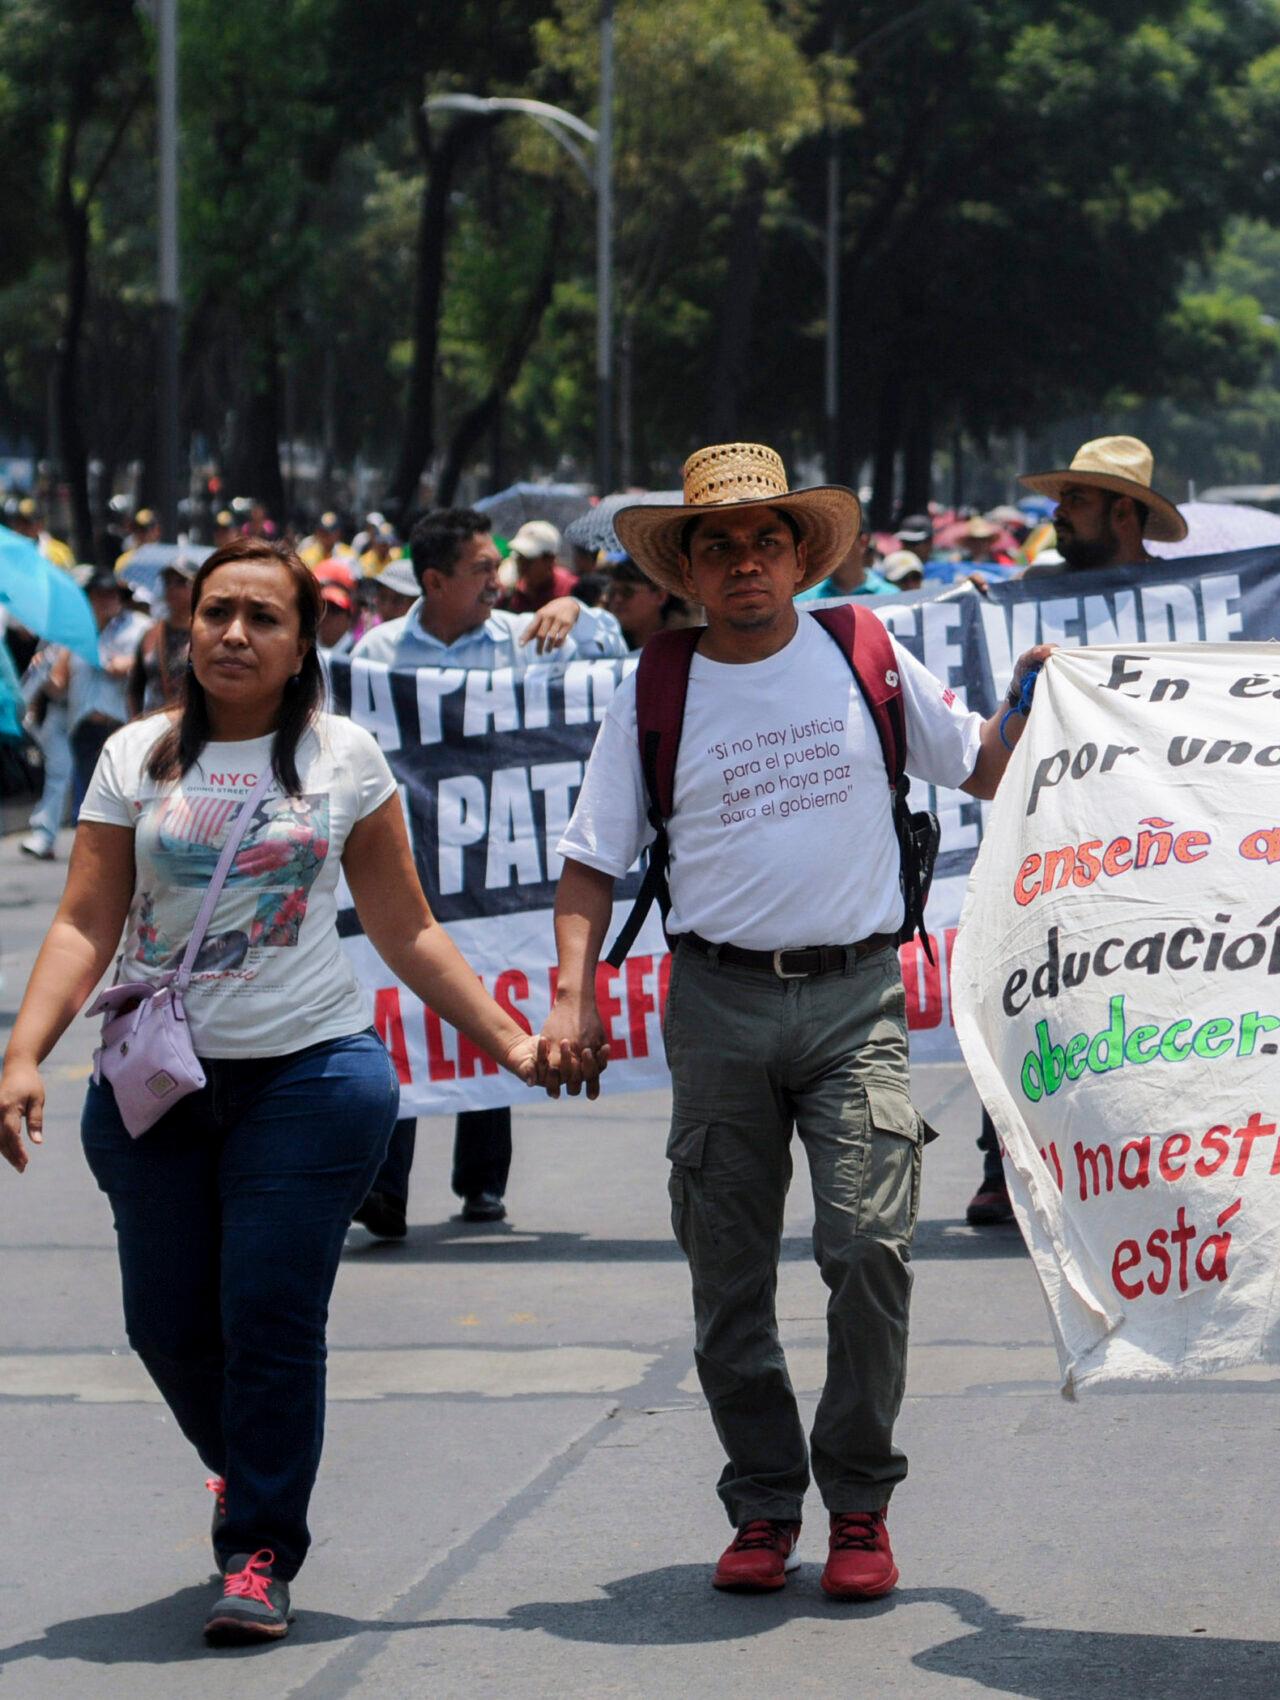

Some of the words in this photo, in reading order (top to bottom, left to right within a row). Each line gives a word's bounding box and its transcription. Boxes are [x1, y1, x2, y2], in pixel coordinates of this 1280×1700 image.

[1099, 655, 1189, 702] En
[732, 738, 753, 754] no
[756, 729, 787, 748] hay
[791, 717, 845, 743] justicia
[210, 773, 258, 787] NYC
[723, 760, 761, 785] para
[766, 752, 780, 770] el
[783, 742, 840, 768] pueblo
[1026, 741, 1139, 816] por
[722, 787, 750, 807] que
[754, 780, 776, 797] no
[779, 770, 819, 791] haya
[823, 764, 852, 786] paz
[720, 808, 756, 827] para
[761, 800, 775, 816] el
[1014, 817, 1210, 906] enseñe
[1111, 1198, 1242, 1300] está
